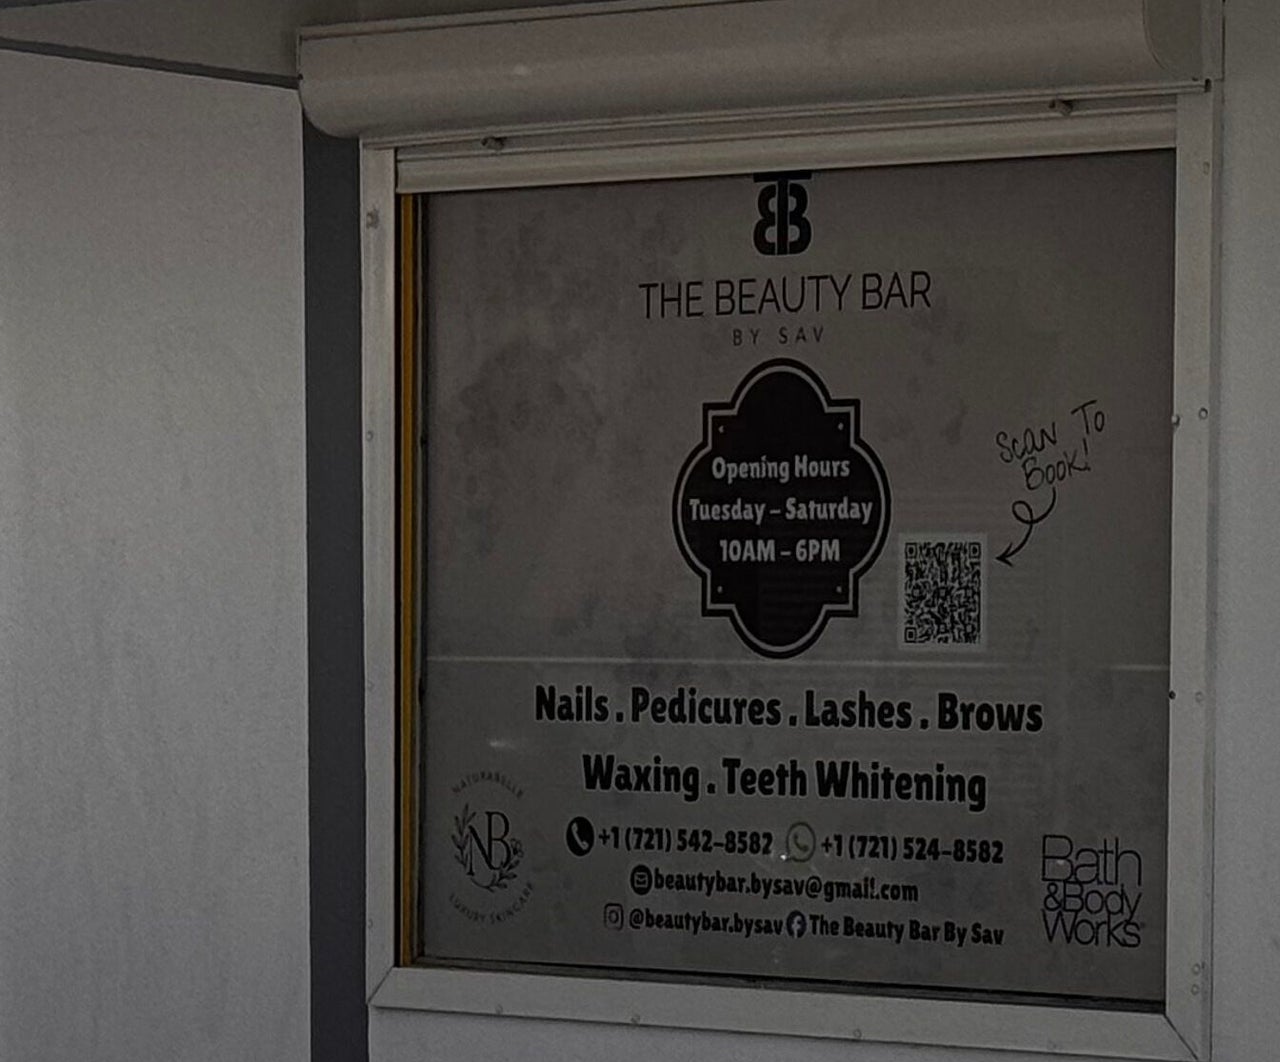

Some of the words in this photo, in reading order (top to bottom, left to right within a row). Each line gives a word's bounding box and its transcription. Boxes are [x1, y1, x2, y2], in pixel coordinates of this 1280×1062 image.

[639, 281, 704, 319] THE
[716, 274, 852, 316] BEAUTY
[862, 271, 931, 310] BAR
[733, 328, 761, 346] BY
[779, 326, 824, 345] SAV
[711, 455, 791, 485] Opening
[794, 454, 851, 479] Hours
[689, 497, 767, 527] Tuesday
[785, 496, 873, 526] Saturday
[720, 539, 776, 563] 10AM
[795, 538, 840, 563] 6PM
[535, 685, 609, 721] Nails
[631, 688, 781, 726] Pedicures
[806, 690, 912, 728] Lashes
[938, 693, 1043, 732] Brows
[582, 754, 700, 800] Waxing
[722, 758, 808, 797] Teeth
[815, 761, 987, 812] Whitening
[599, 827, 619, 848] +1
[625, 827, 671, 851] (721)
[677, 828, 773, 855] 542-8582
[822, 835, 843, 857] +1
[849, 835, 898, 861] (721)
[903, 837, 1004, 864] 524-8582
[1042, 834, 1141, 886] Bath
[654, 868, 918, 902] beautybar.bysav@gmail.com
[1044, 882, 1142, 924] &Body
[629, 908, 783, 938] @beautybar.bysav
[809, 914, 840, 936] The
[843, 916, 905, 944] Beauty
[909, 920, 940, 942] Bar
[944, 921, 967, 947] By
[971, 923, 1004, 945] Sav
[1041, 907, 1141, 948] Works
